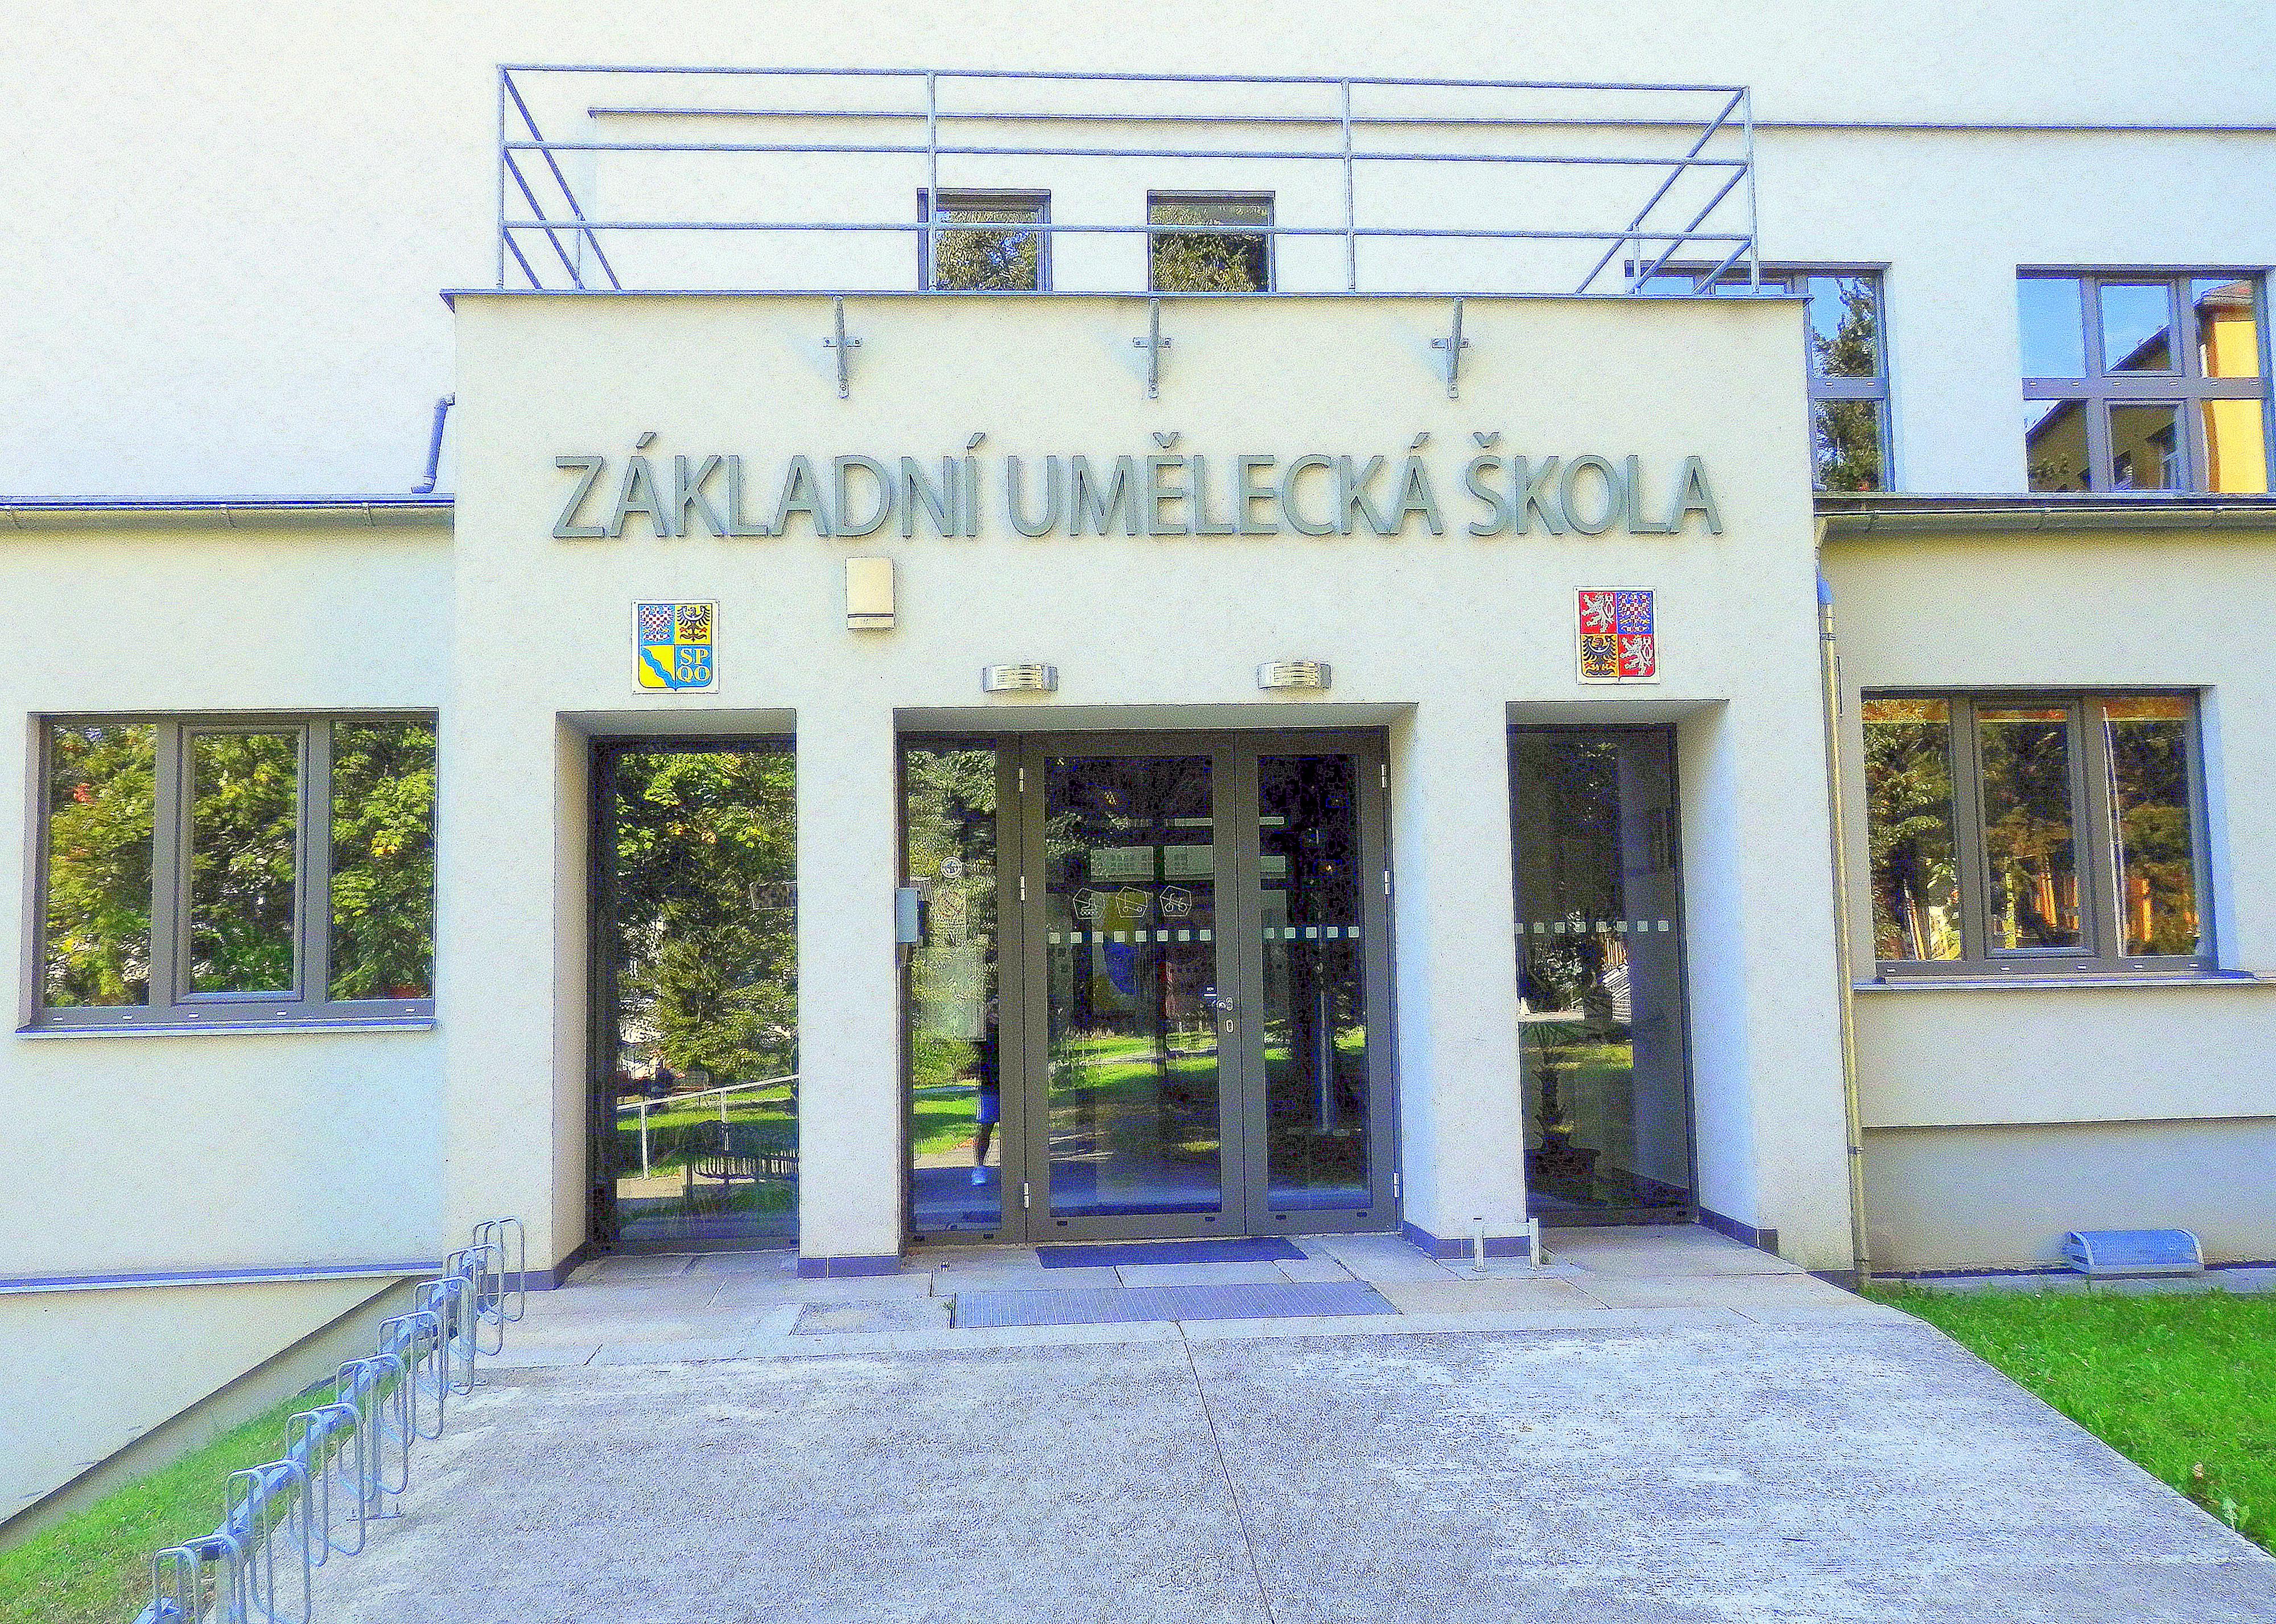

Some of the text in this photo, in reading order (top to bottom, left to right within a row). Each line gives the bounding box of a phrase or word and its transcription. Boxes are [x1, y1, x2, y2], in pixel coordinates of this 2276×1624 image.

[552, 431, 1724, 538] ZÁKLADNÍ UMĚLECKÁ ŠKOLA
[679, 648, 710, 666] SP
[677, 666, 711, 683] QO
